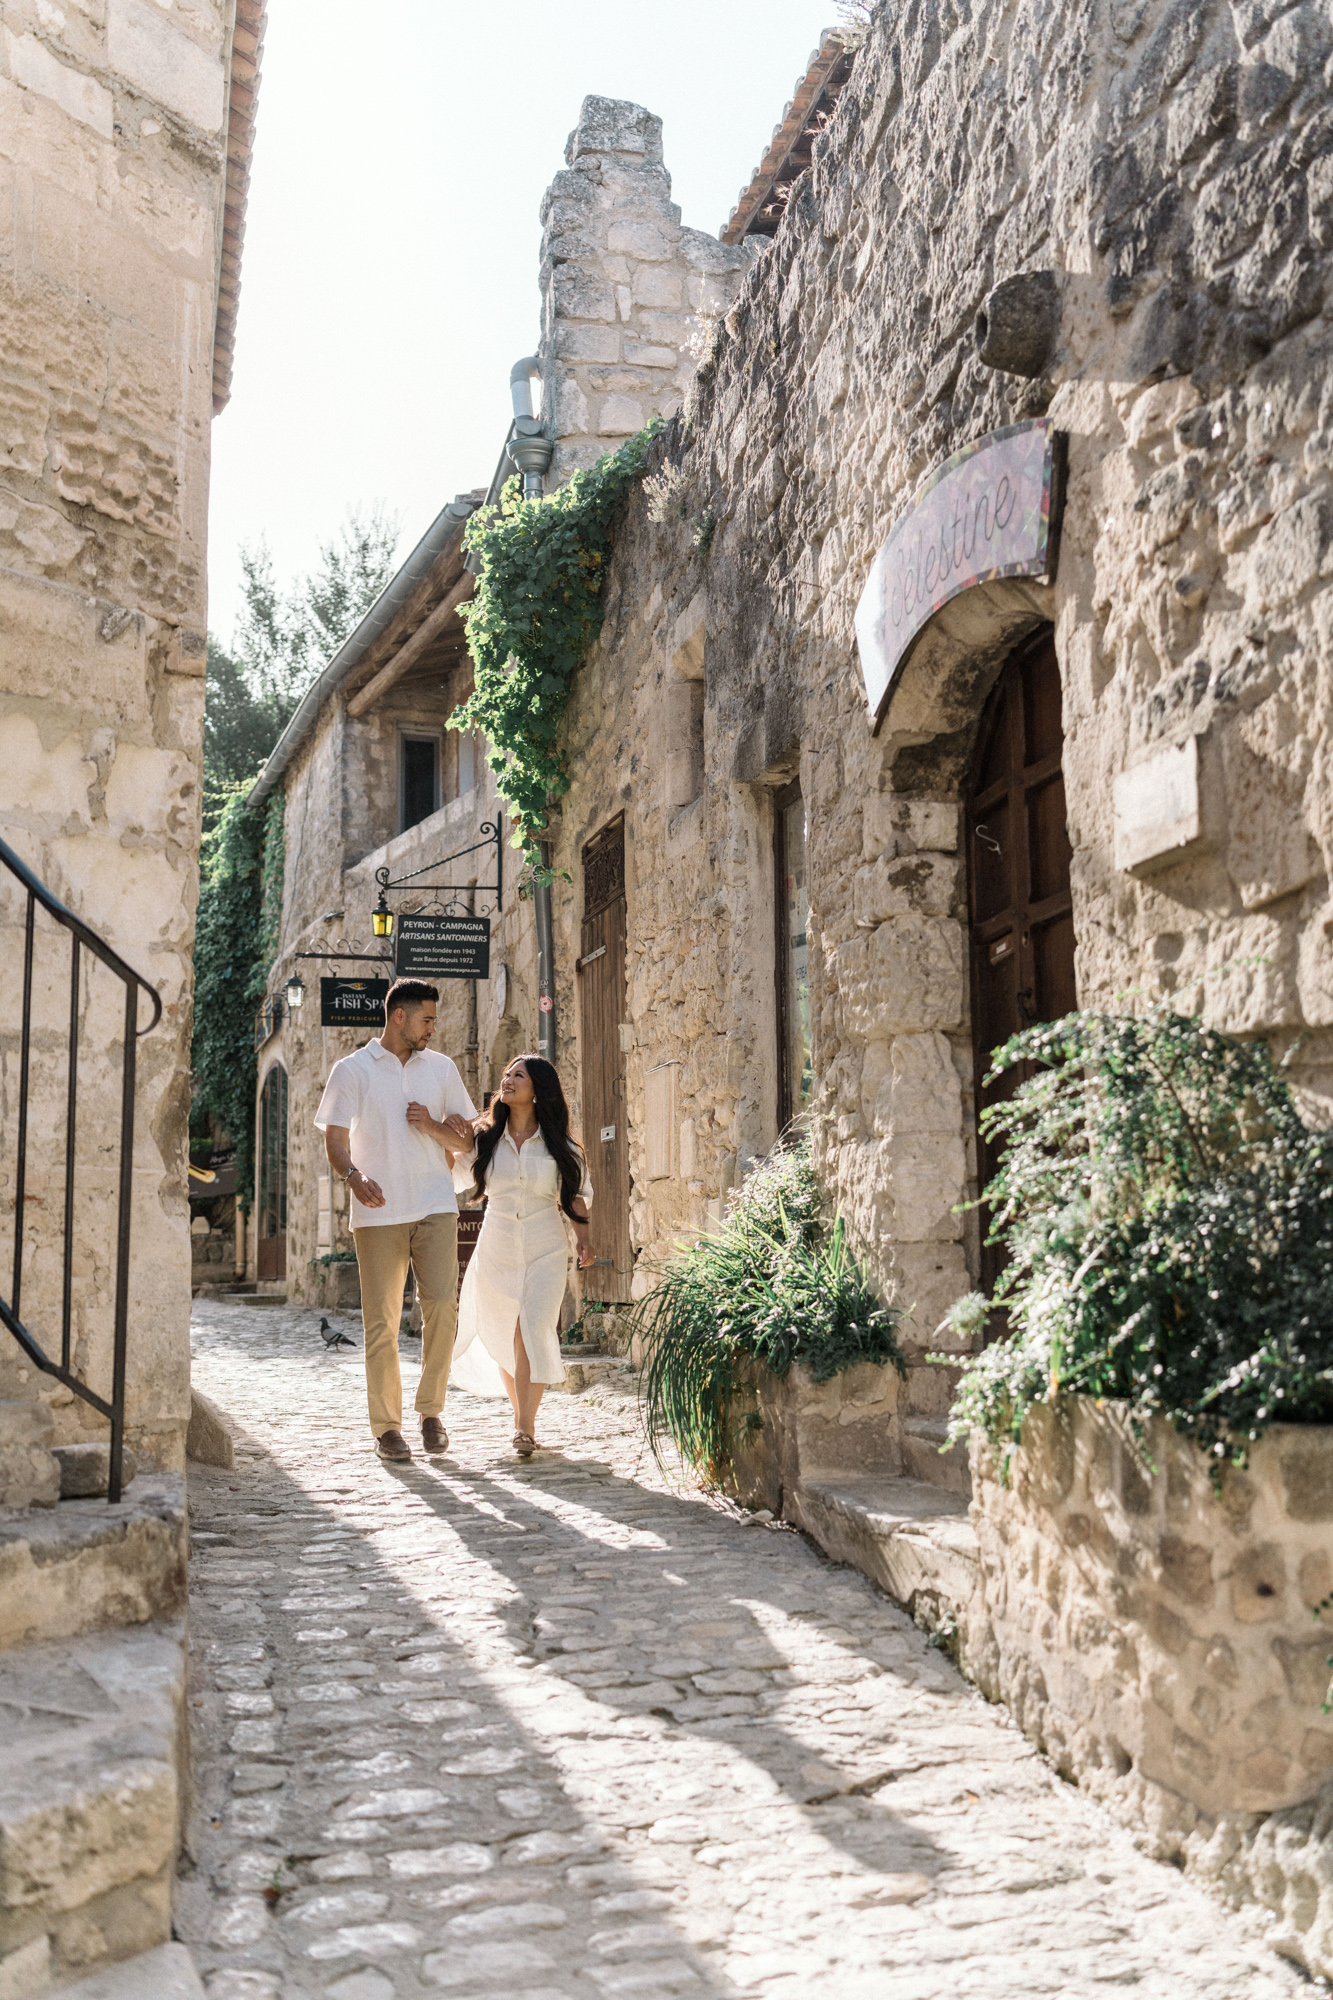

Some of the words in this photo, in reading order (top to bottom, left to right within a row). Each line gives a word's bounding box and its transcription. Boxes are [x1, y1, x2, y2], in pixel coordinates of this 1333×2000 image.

[403, 920, 435, 929] PEYRON
[440, 922, 484, 931] CAMPAGNA
[399, 932, 436, 941] ARTISANS
[436, 933, 488, 943] SANTONNIERS
[439, 956, 459, 964] depuis
[333, 997, 361, 1009] FISH
